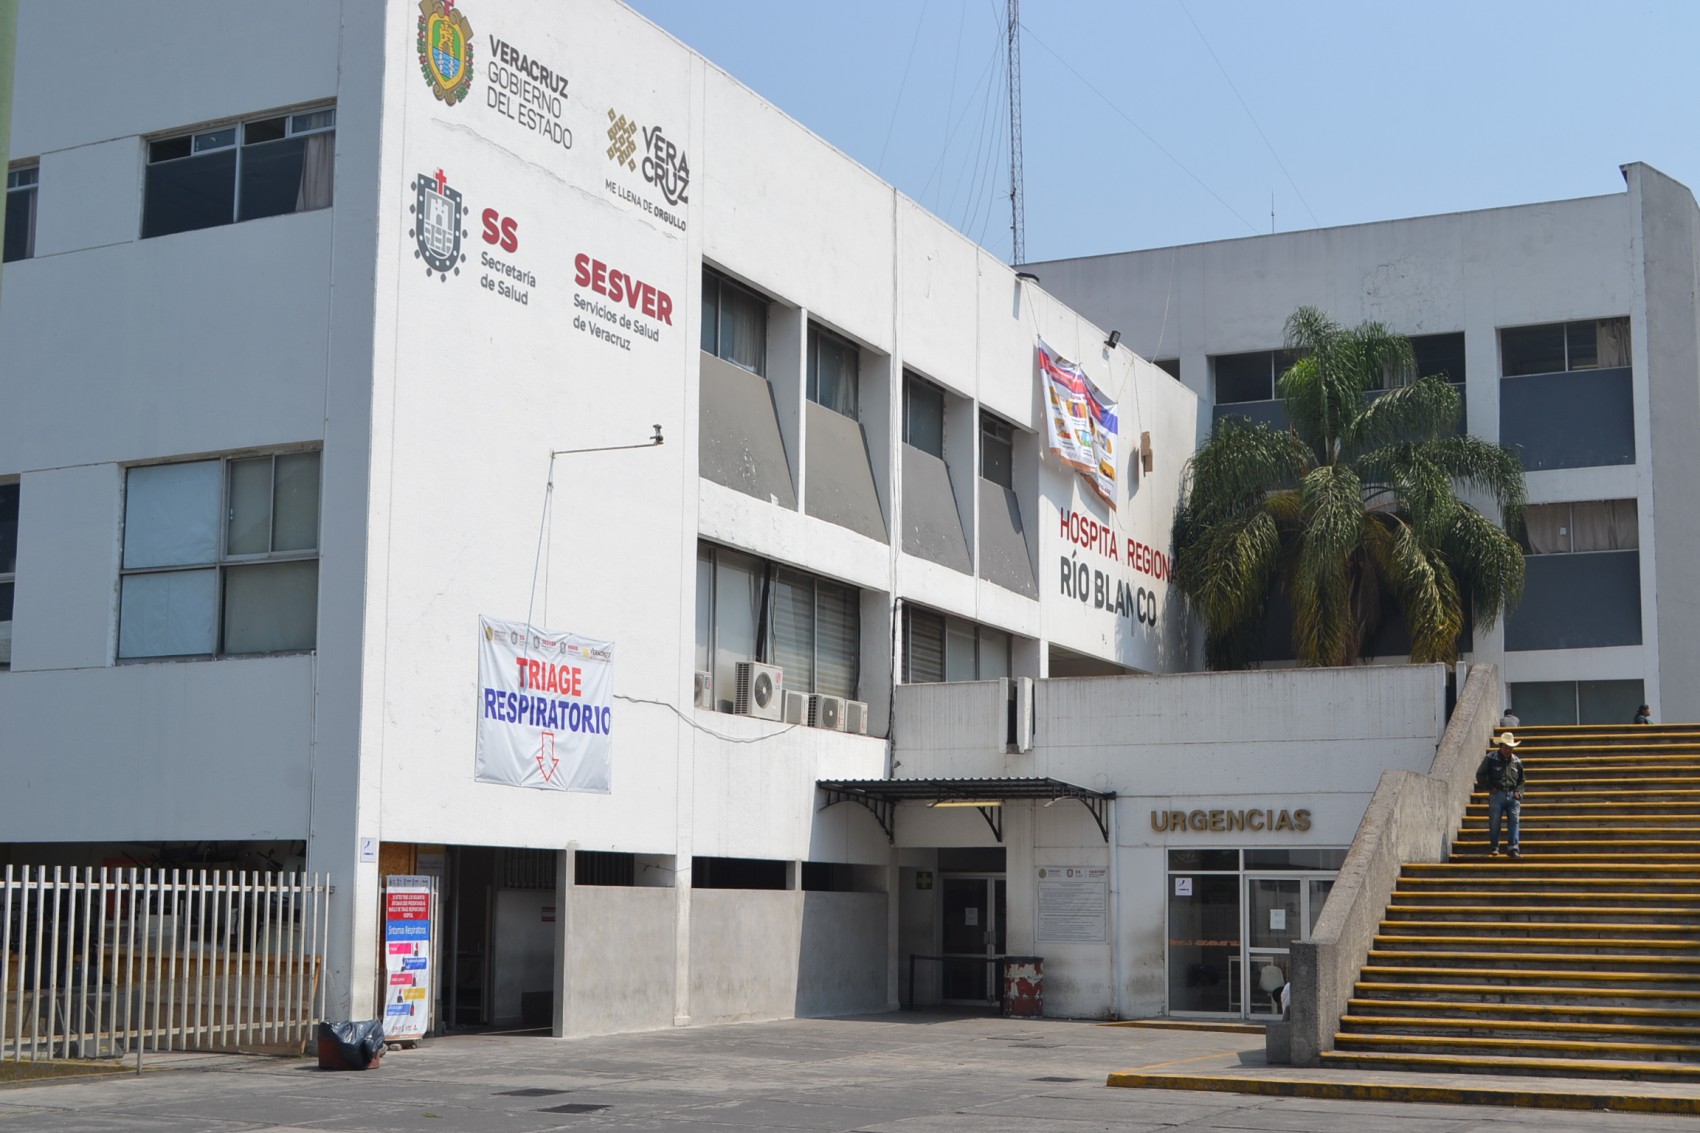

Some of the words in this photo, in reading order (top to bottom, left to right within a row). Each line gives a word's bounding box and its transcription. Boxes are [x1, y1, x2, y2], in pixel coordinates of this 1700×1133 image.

[488, 61, 562, 119] GOBIERNO
[489, 34, 569, 99] VERACRUZ
[487, 85, 515, 120] DEL
[518, 102, 573, 150] ESTADO
[642, 125, 690, 179] VERA
[605, 178, 617, 194] ME
[618, 185, 642, 209] LLENA
[643, 199, 653, 214] DE
[653, 206, 687, 232] ORGULLO
[641, 155, 690, 206] CRUZ
[482, 208, 518, 253] SS
[480, 273, 495, 291] de
[497, 279, 529, 306] Salud
[481, 251, 537, 288] Secretaría
[574, 253, 673, 327] SESVER
[573, 293, 617, 324] Servicios
[619, 314, 632, 330] de
[633, 319, 660, 343] Salud
[573, 315, 587, 332] de
[588, 320, 631, 352] Veracruz
[1127, 537, 1178, 584] REGIONA
[1060, 549, 1090, 603] RÍO
[1094, 569, 1157, 628] BLANCO
[516, 657, 582, 697] TRIAGE
[484, 688, 612, 736] RESPIRATORIO
[1150, 808, 1312, 833] URGENCIAS
